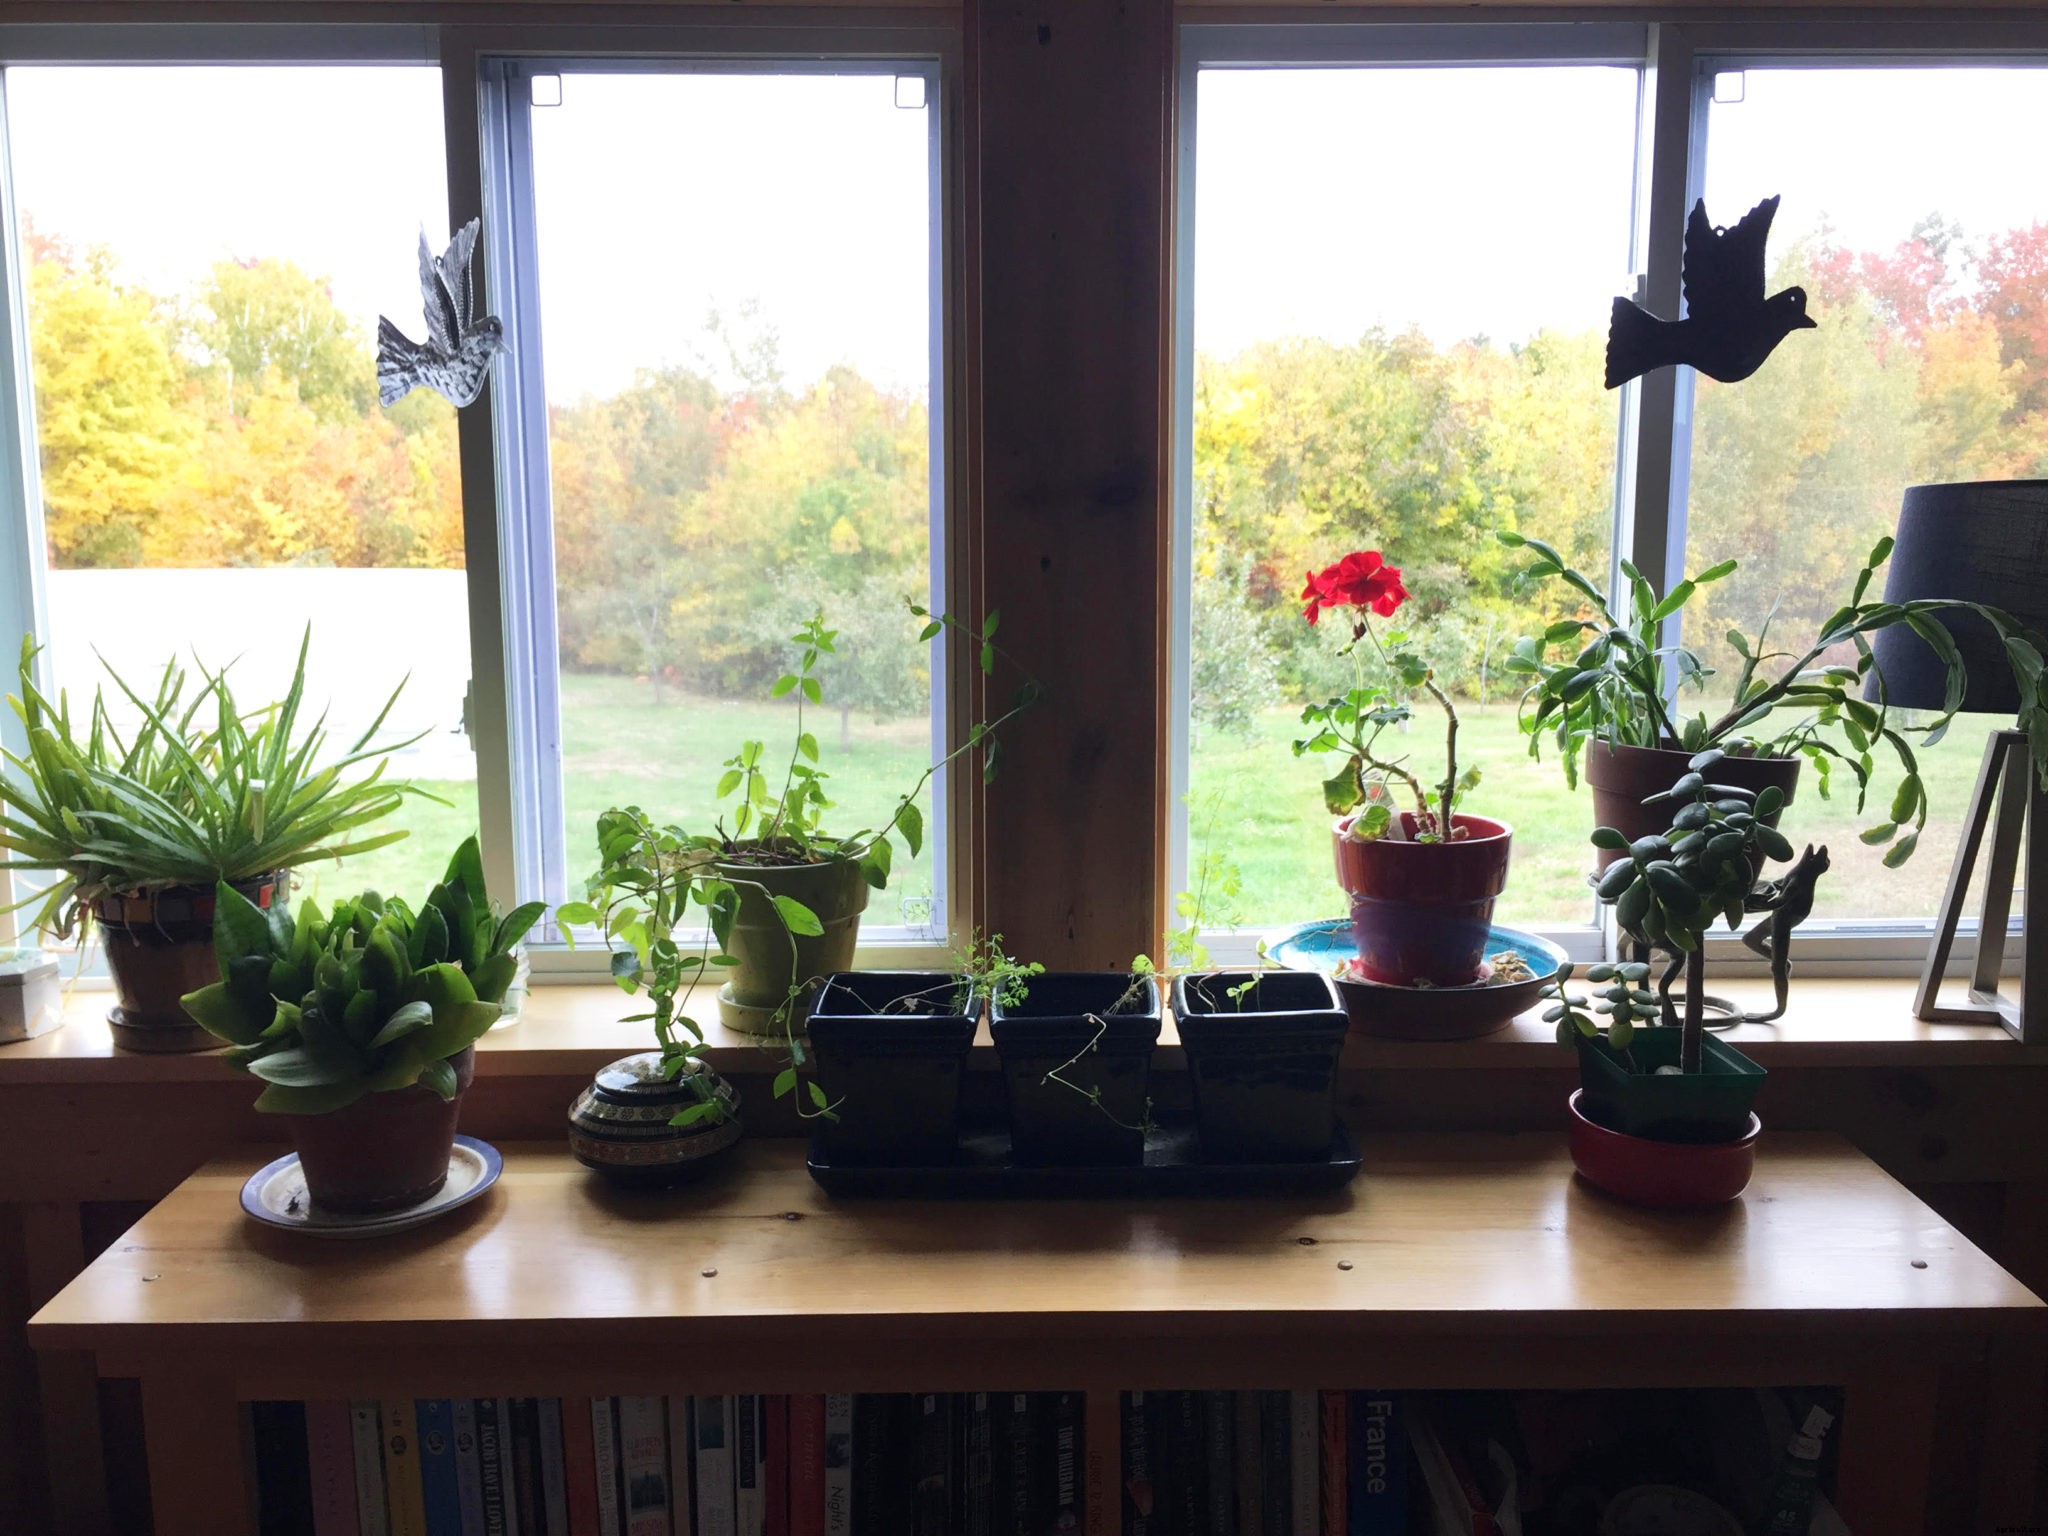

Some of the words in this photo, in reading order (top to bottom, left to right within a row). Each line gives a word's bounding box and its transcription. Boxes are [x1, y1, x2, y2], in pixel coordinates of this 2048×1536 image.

[481, 1423, 498, 1461] JACOB
[596, 1410, 611, 1462] EDWARD
[1058, 1424, 1074, 1450] TONY
[1366, 1400, 1393, 1495] France
[483, 1463, 499, 1493] HAVE
[600, 1466, 613, 1502] ABBEY
[1057, 1452, 1075, 1506] HILLERMAN
[1089, 1450, 1104, 1488] LAURIE
[828, 1486, 847, 1531] Night's
